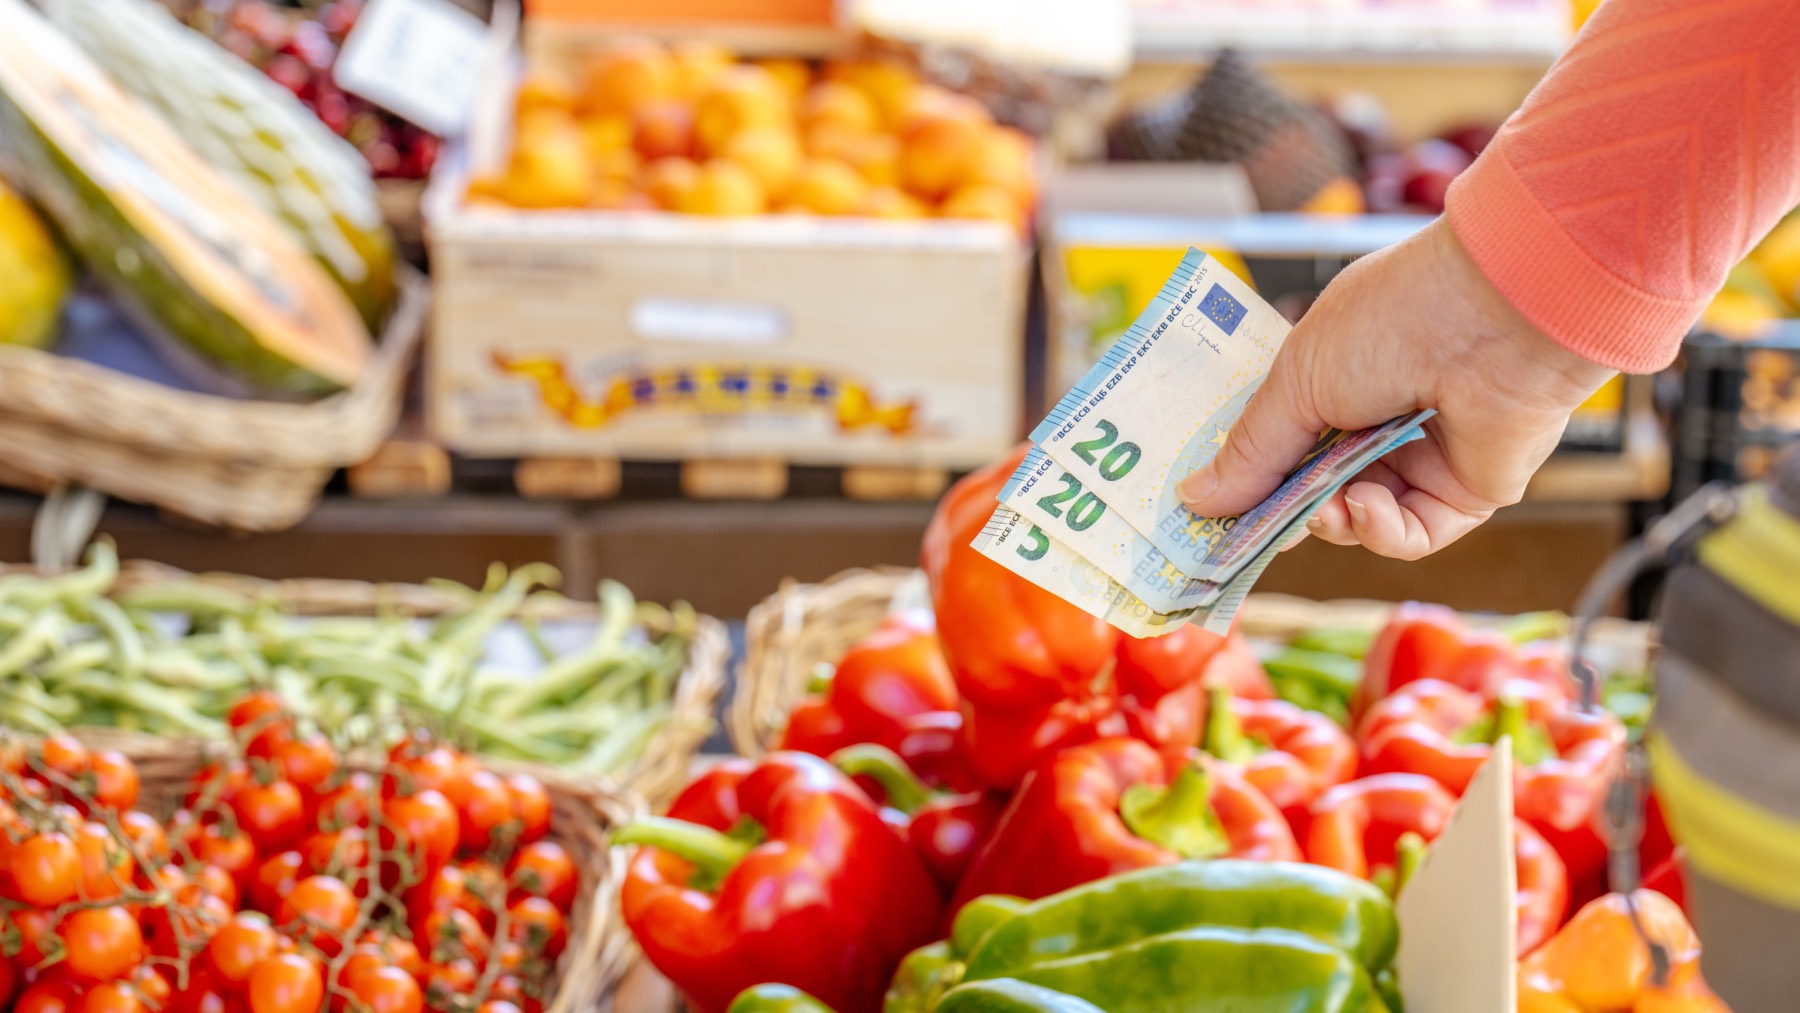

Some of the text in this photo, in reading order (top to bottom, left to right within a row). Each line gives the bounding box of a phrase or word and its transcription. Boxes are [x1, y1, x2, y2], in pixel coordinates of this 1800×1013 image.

[1073, 406, 1091, 423] ECB
[1106, 373, 1123, 391] EZB
[1121, 356, 1137, 374] EKP
[1137, 339, 1153, 357] EKT
[1151, 322, 1168, 340] EKB
[1181, 286, 1197, 305] EBC
[1194, 267, 1208, 285] 2015
[1036, 459, 1053, 476] ECB
[1070, 418, 1142, 482] 20
[1036, 472, 1107, 532] 20
[1016, 524, 1050, 561] 5
